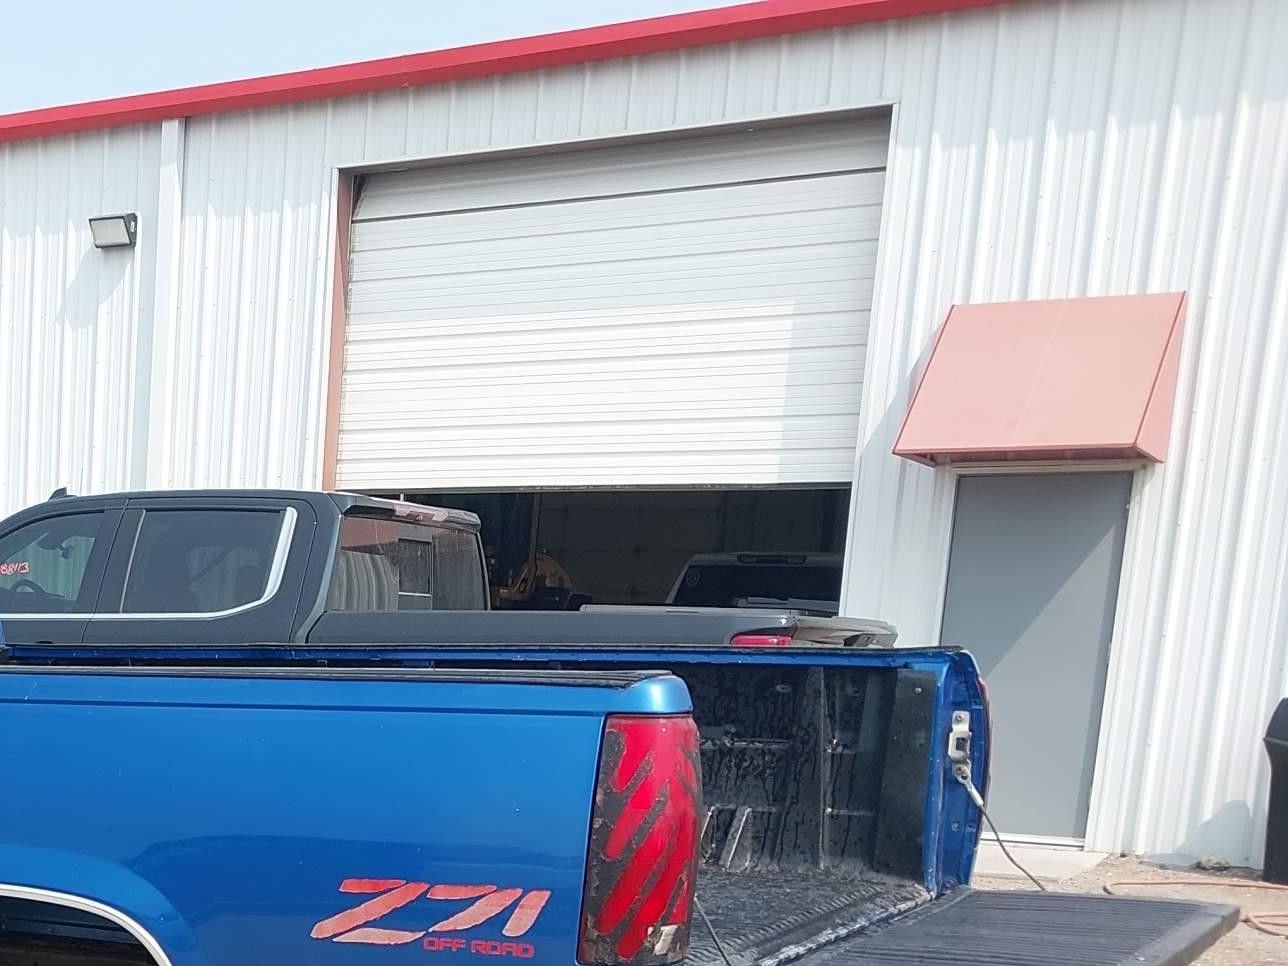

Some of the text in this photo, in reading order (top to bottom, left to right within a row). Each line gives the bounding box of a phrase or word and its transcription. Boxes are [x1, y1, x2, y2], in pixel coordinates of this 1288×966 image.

[309, 877, 553, 946] Z71
[423, 937, 536, 958] OFF ROAD
